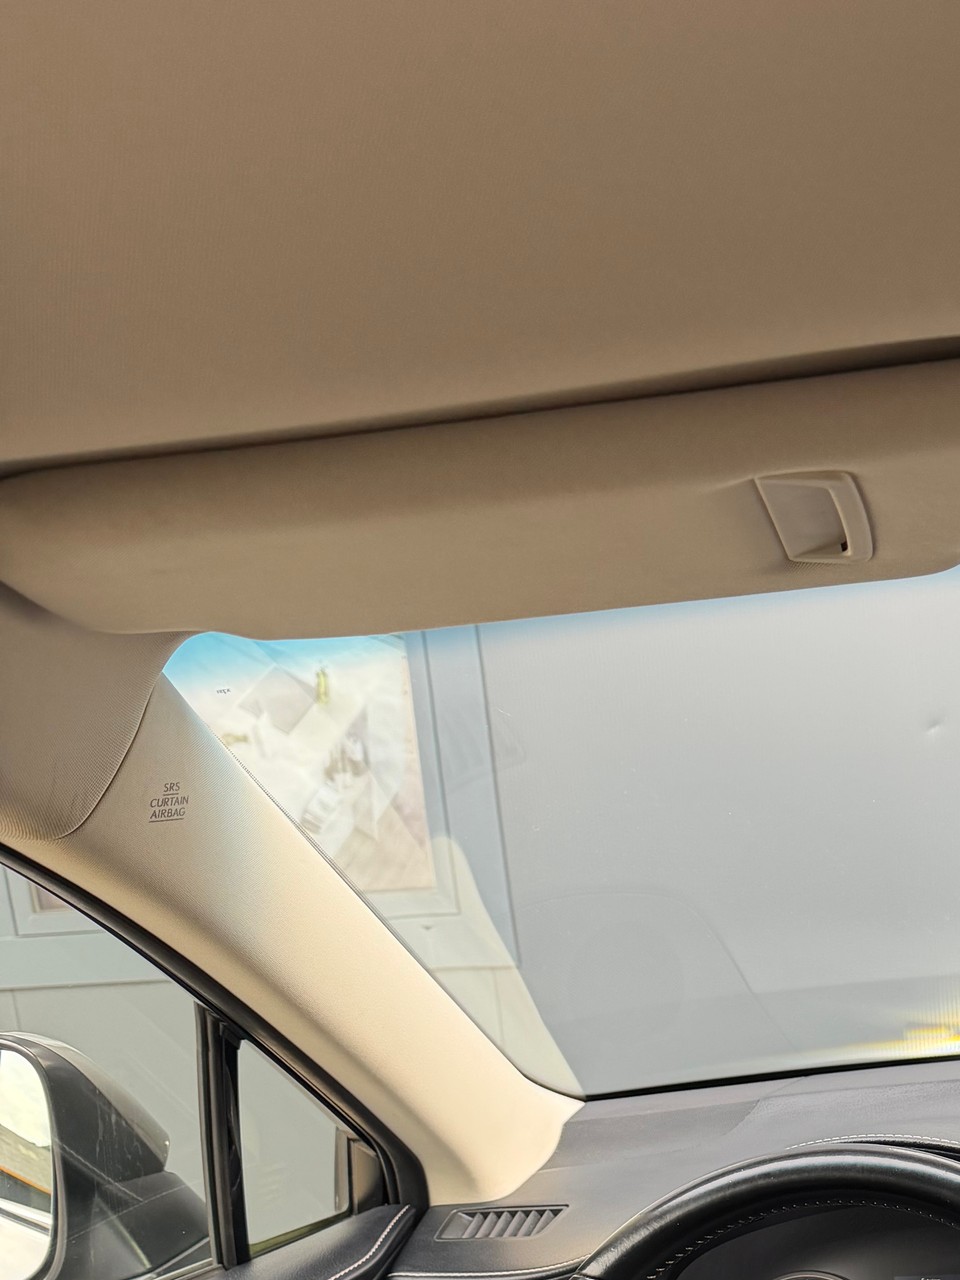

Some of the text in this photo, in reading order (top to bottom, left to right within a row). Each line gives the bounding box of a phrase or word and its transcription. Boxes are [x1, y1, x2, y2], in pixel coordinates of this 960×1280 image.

[163, 782, 180, 793] SRS
[149, 795, 189, 808] CURTAIN
[150, 807, 186, 819] AIRBAG
